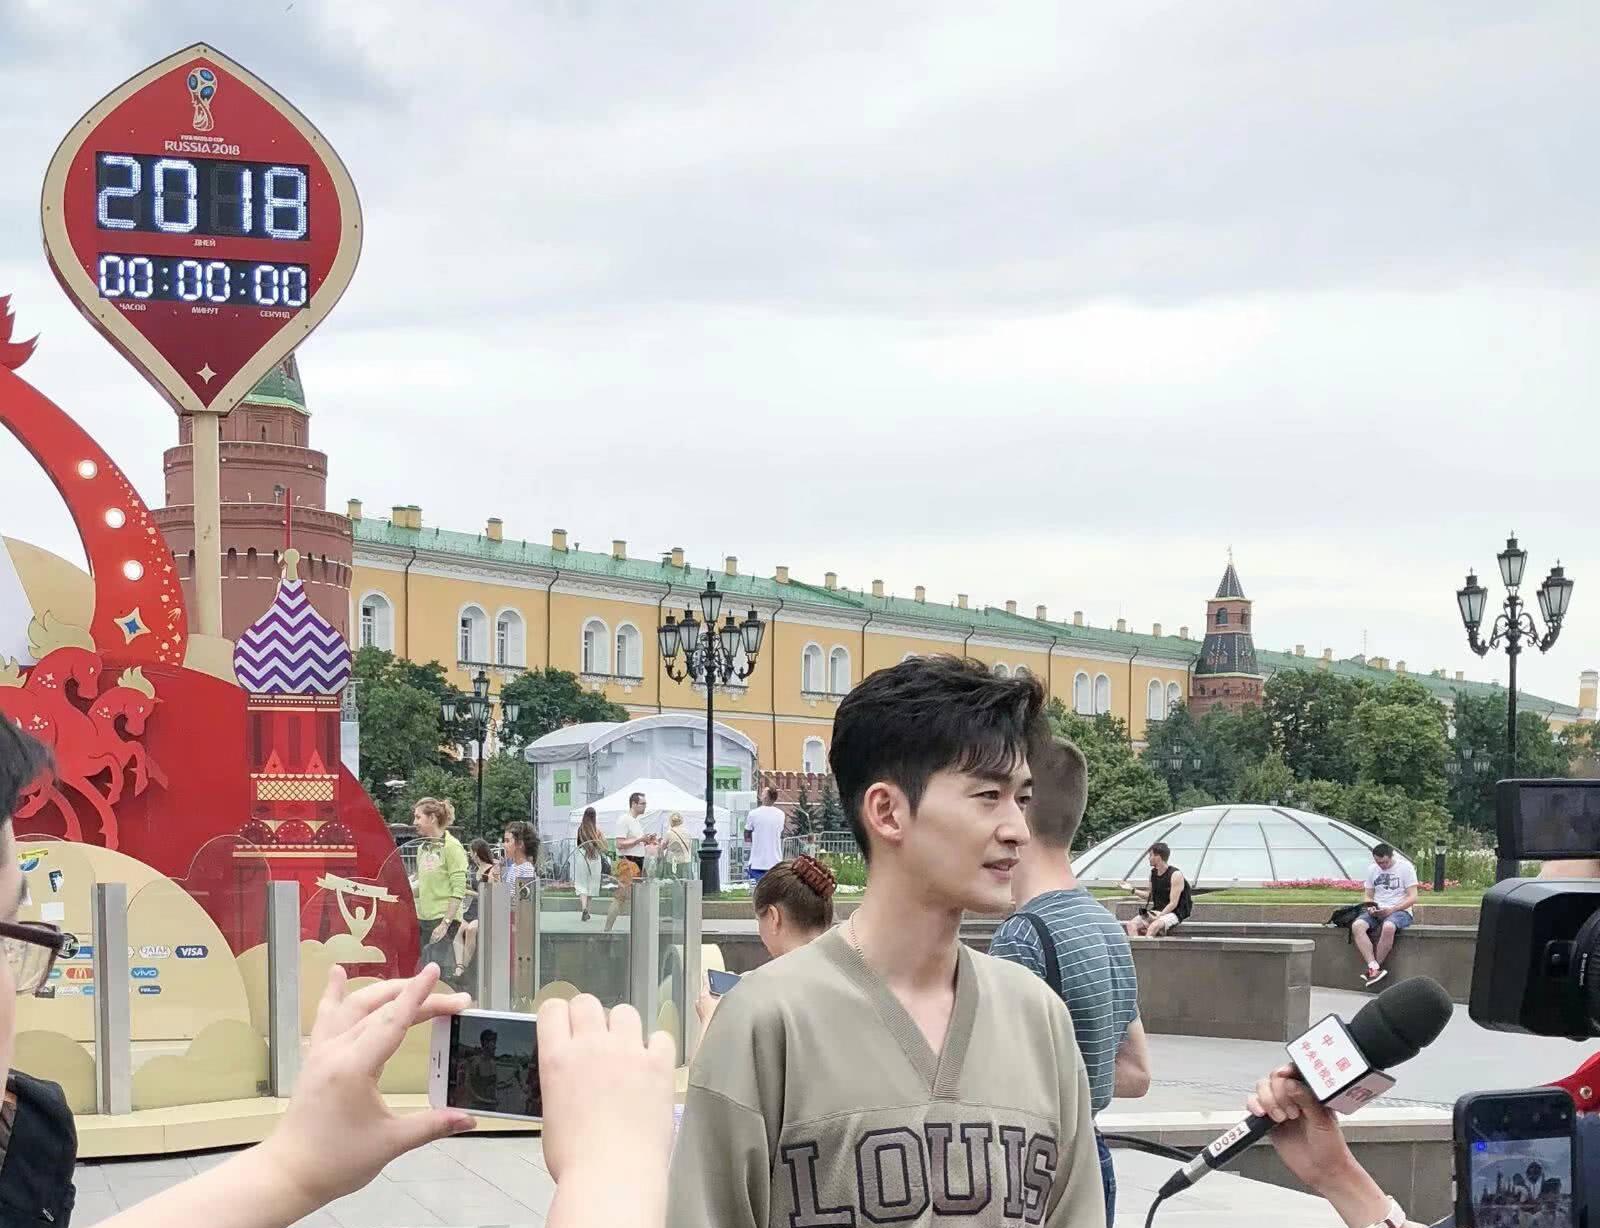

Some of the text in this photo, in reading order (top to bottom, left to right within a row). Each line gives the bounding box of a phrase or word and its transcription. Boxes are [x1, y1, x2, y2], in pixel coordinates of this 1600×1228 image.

[165, 140, 240, 155] RUSSIA 2018
[98, 155, 307, 240] 2018
[194, 239, 216, 247] ДНЕЙ
[119, 303, 147, 311] ЧАСОВ
[191, 306, 219, 315] МИНУТ
[260, 310, 290, 319] СЕКУНД
[555, 782, 571, 794] RT
[715, 777, 741, 790] RT
[180, 947, 203, 956] VISA
